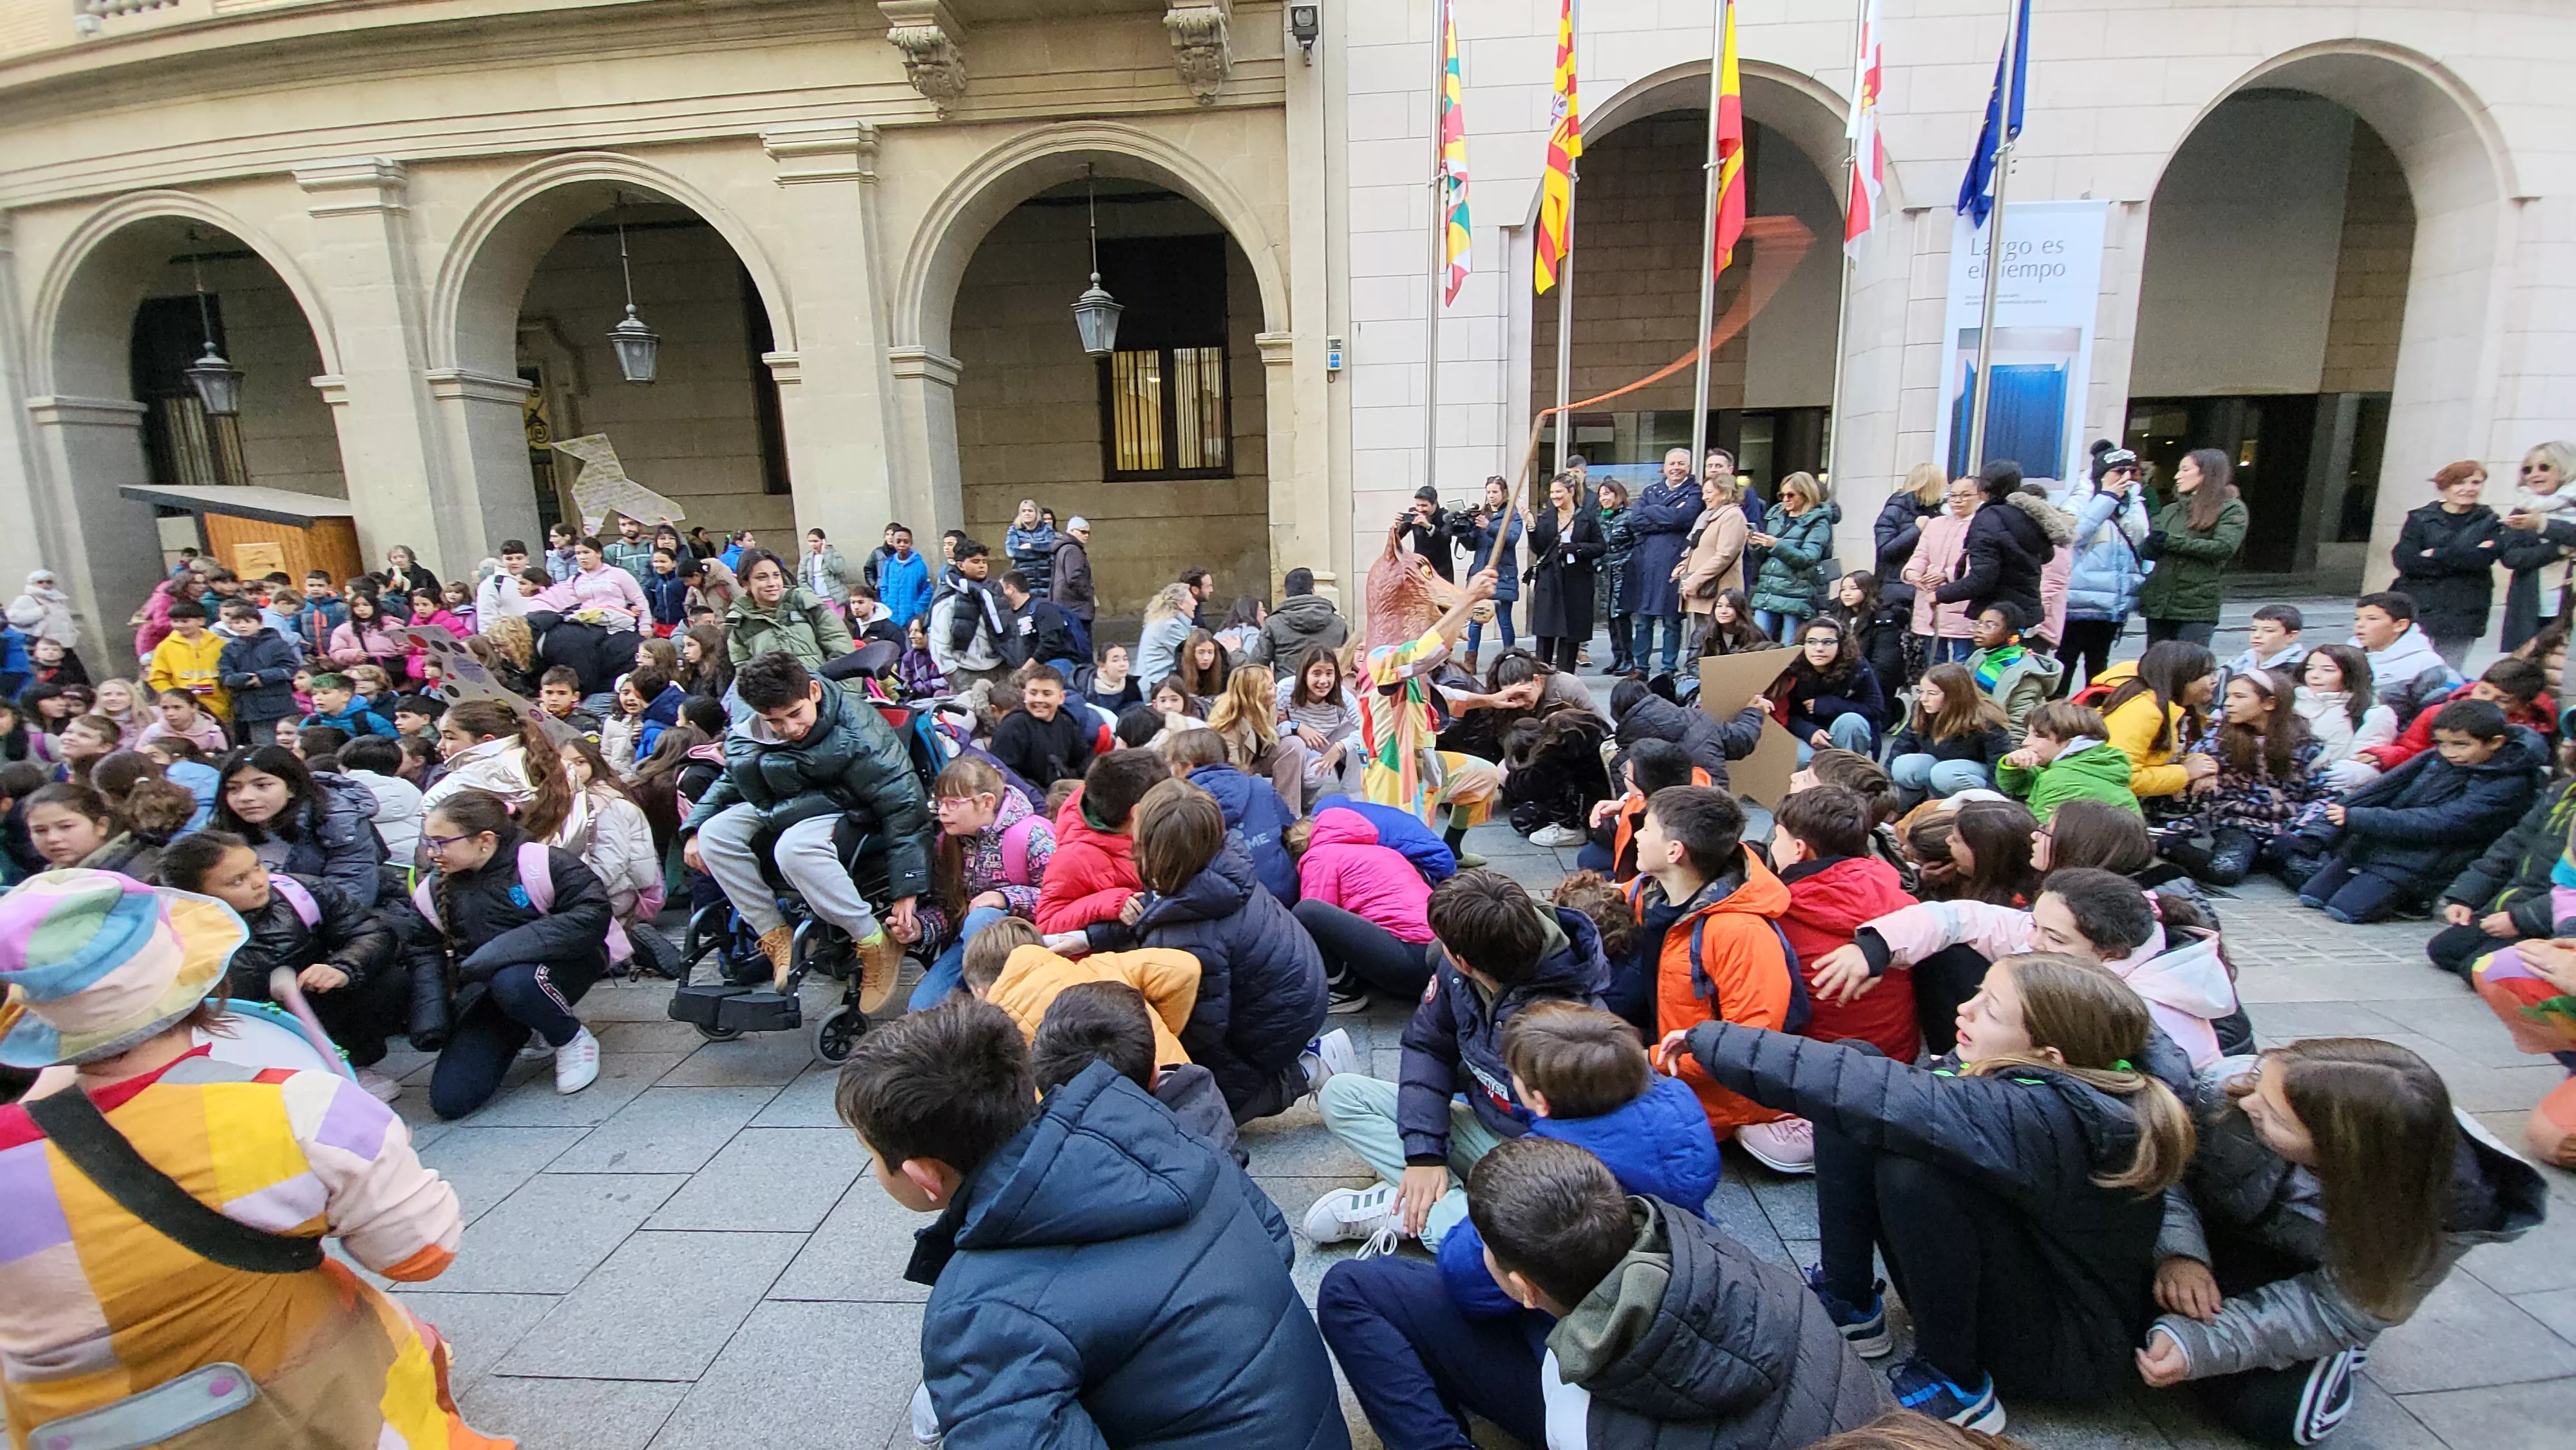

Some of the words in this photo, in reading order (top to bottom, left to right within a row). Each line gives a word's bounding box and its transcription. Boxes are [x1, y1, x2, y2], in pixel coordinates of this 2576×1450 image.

[2042, 240, 2065, 254] es
[1968, 259, 1985, 279] el
[2000, 263, 2067, 283] iempo
